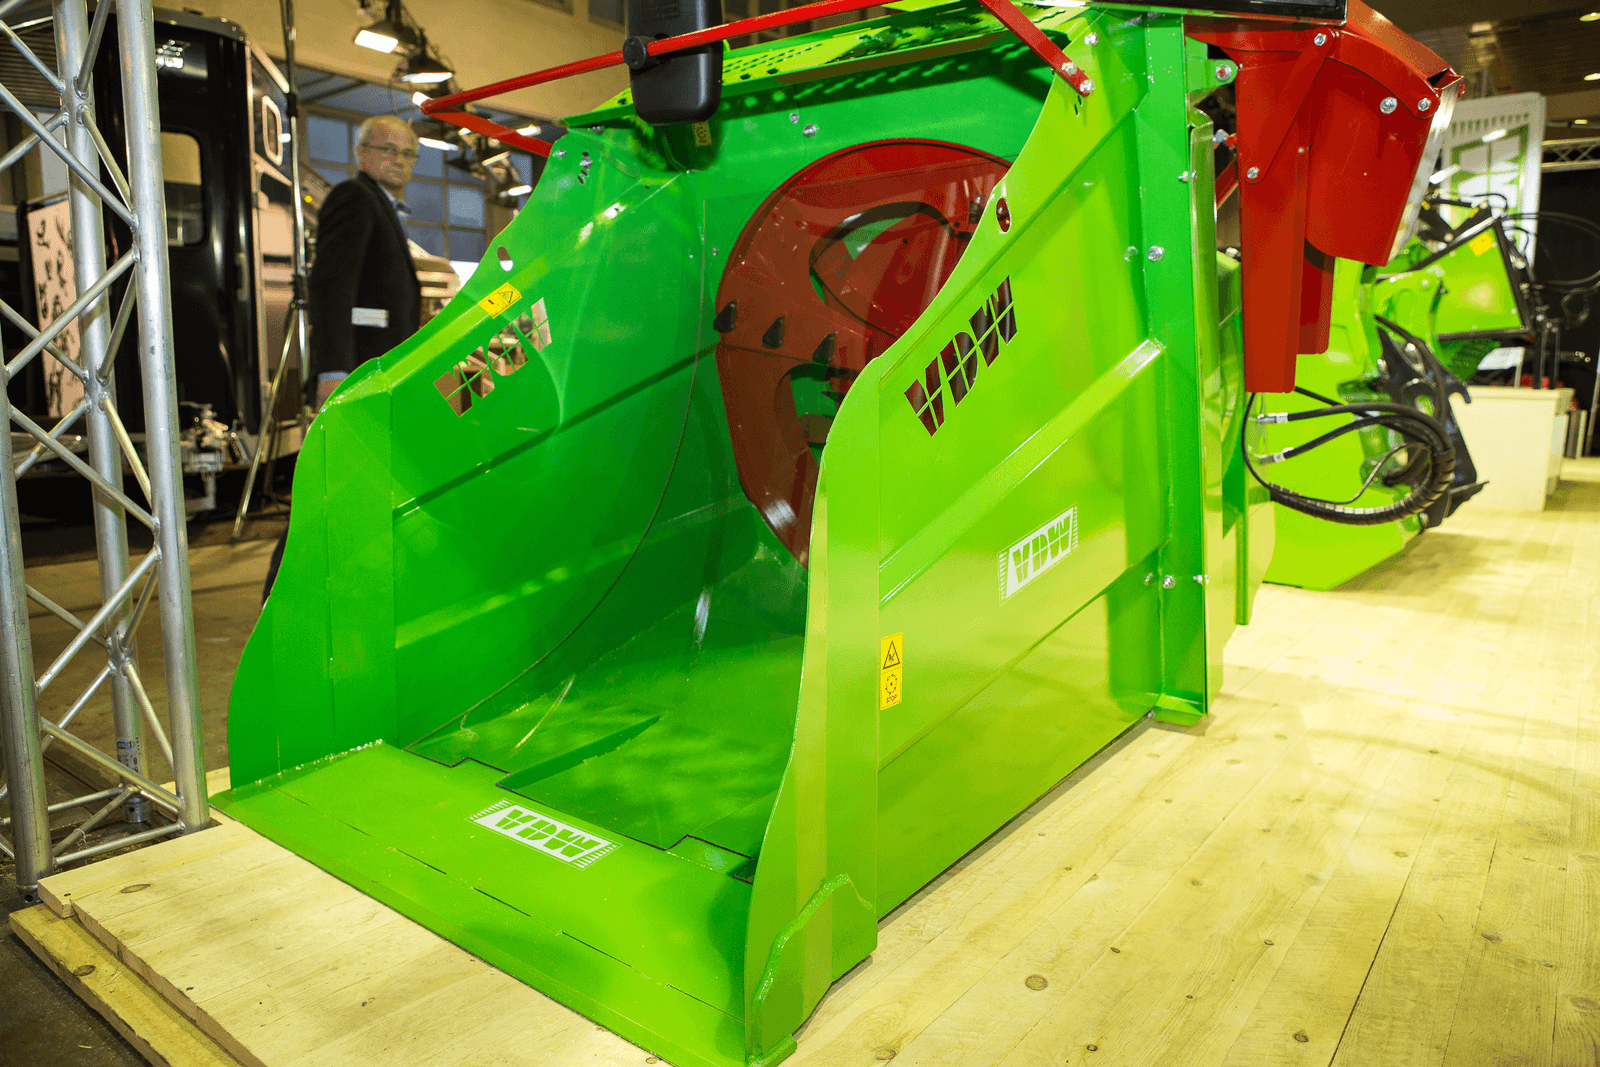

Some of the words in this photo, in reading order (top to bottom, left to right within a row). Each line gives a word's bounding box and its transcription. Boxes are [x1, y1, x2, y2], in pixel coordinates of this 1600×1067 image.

[904, 275, 1018, 437] VDW
[1011, 514, 1071, 584] VDW
[494, 808, 602, 858] VDW
